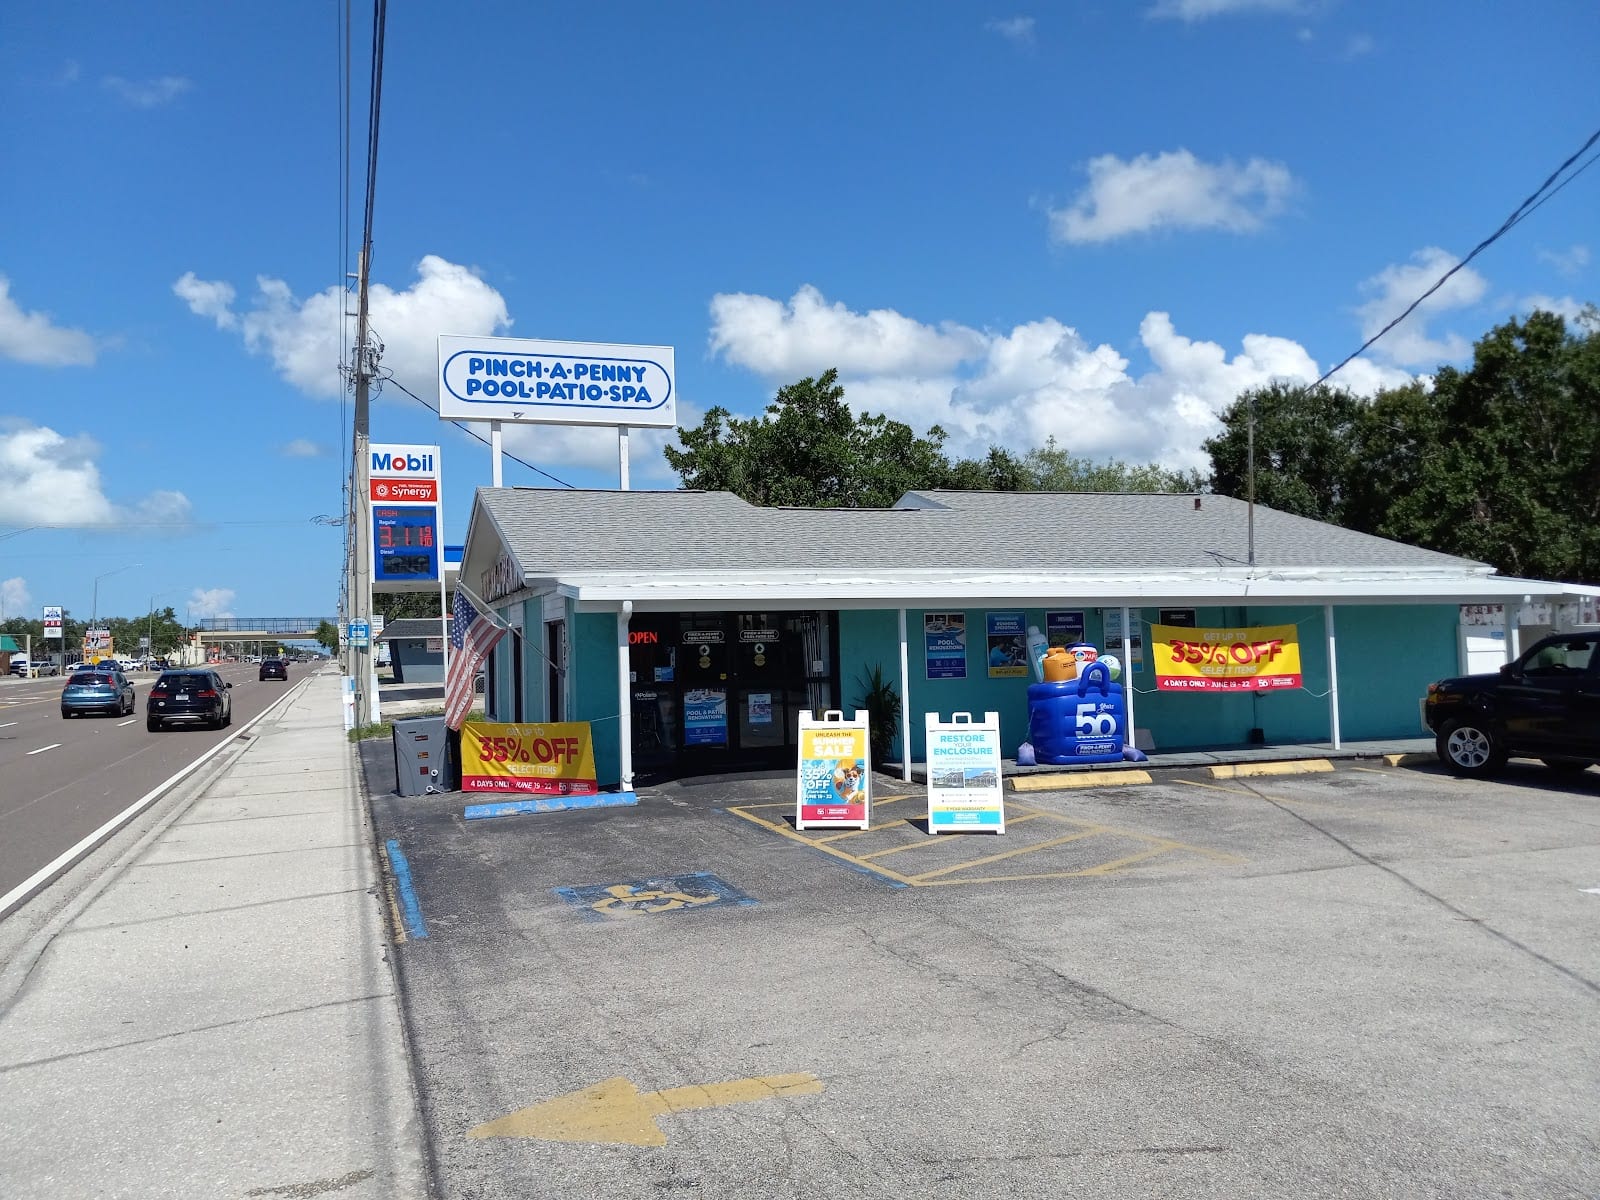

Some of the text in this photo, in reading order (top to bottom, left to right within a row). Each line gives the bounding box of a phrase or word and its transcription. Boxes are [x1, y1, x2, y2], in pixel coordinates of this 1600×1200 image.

[372, 453, 433, 472] Mobil
[392, 486, 431, 498] Synergy
[628, 631, 657, 644] OPEN
[1204, 632, 1246, 641] GET UP TO
[1170, 638, 1283, 665] 35% OFF
[1200, 666, 1256, 675] SELECT ITEMS
[1211, 680, 1228, 688] JUNE
[1075, 703, 1117, 737] 50
[522, 728, 533, 736] UP
[535, 728, 544, 736] TO
[478, 736, 579, 764] 35% OFF
[814, 745, 853, 756] SALE
[508, 764, 557, 775] SELECT ITEMS
[804, 769, 832, 780] 35%
[806, 779, 831, 790] OFF
